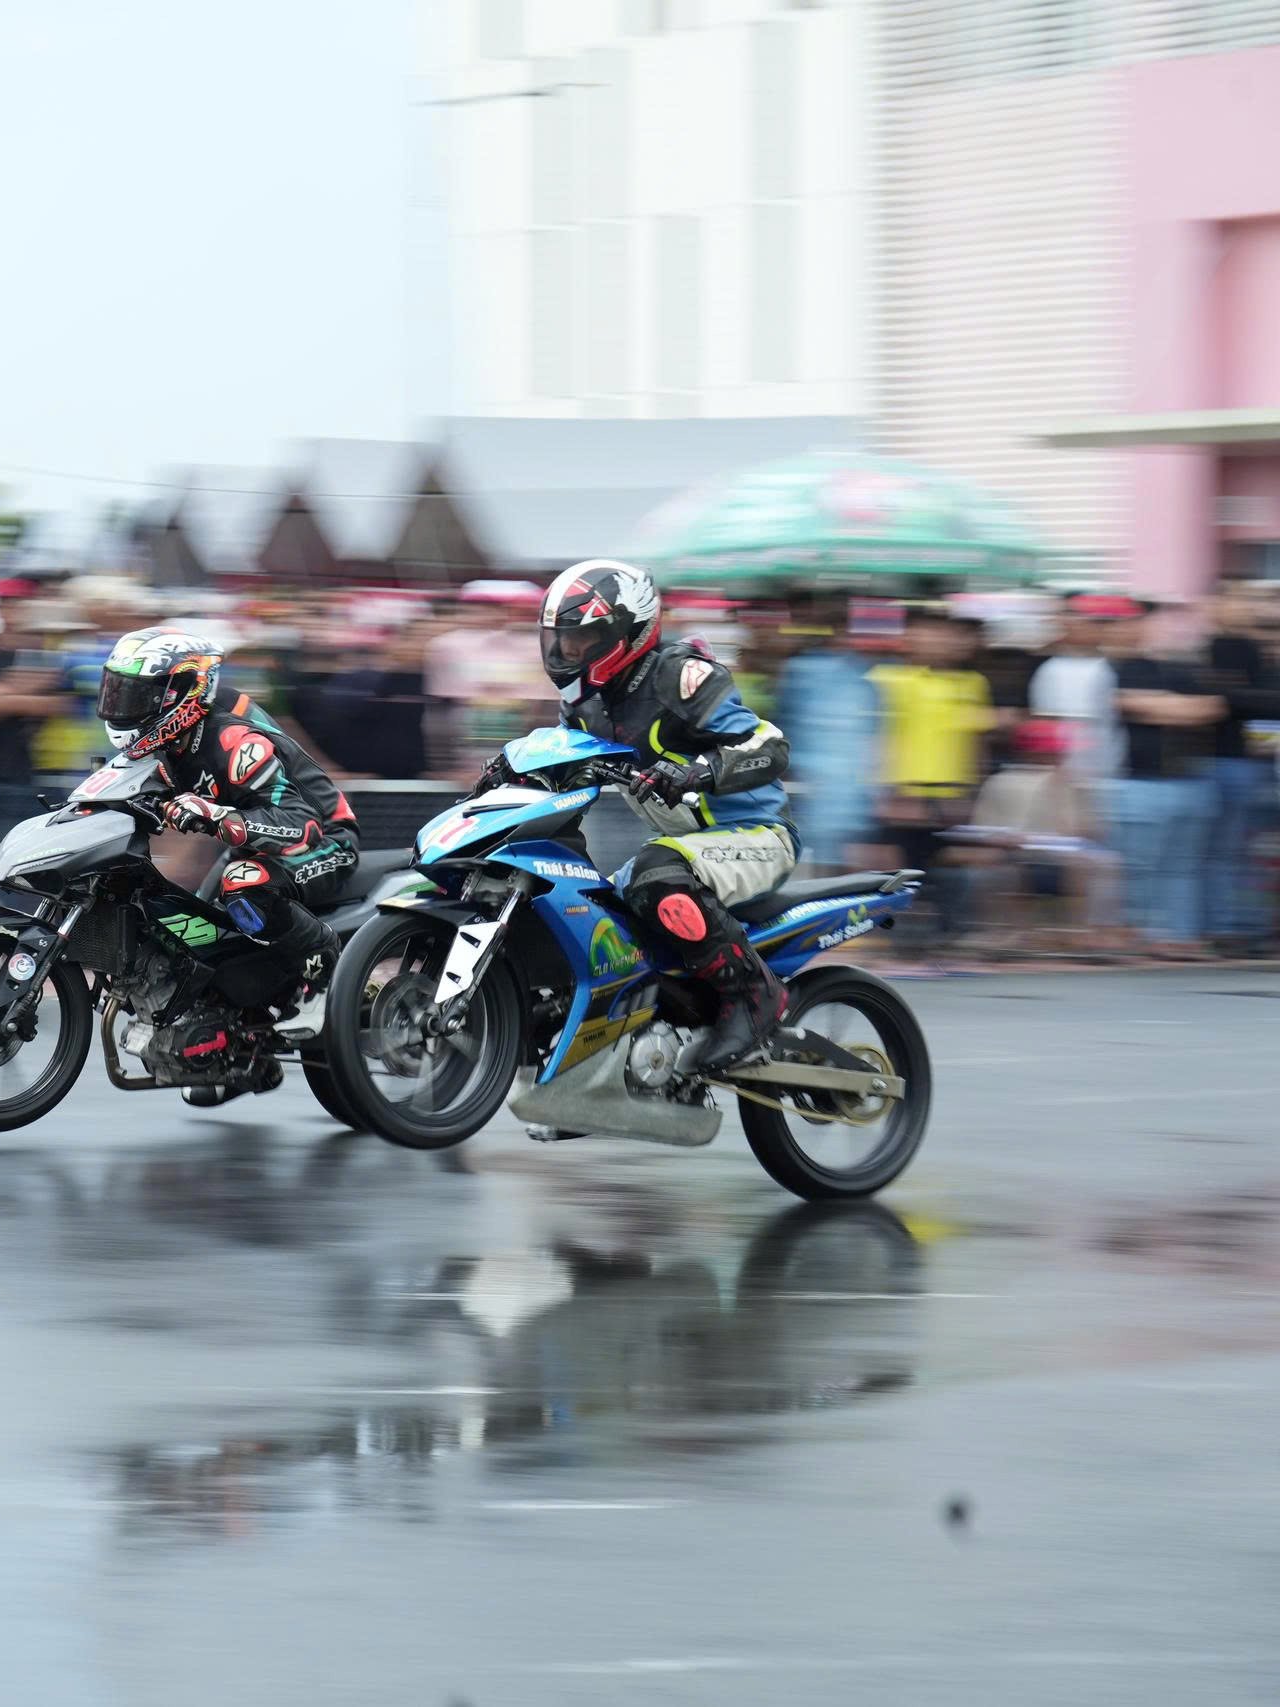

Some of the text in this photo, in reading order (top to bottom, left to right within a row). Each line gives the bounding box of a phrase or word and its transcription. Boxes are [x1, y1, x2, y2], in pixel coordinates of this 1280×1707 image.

[160, 705, 198, 740] NHK
[553, 791, 590, 811] YAMAHA
[565, 863, 601, 882] Salem
